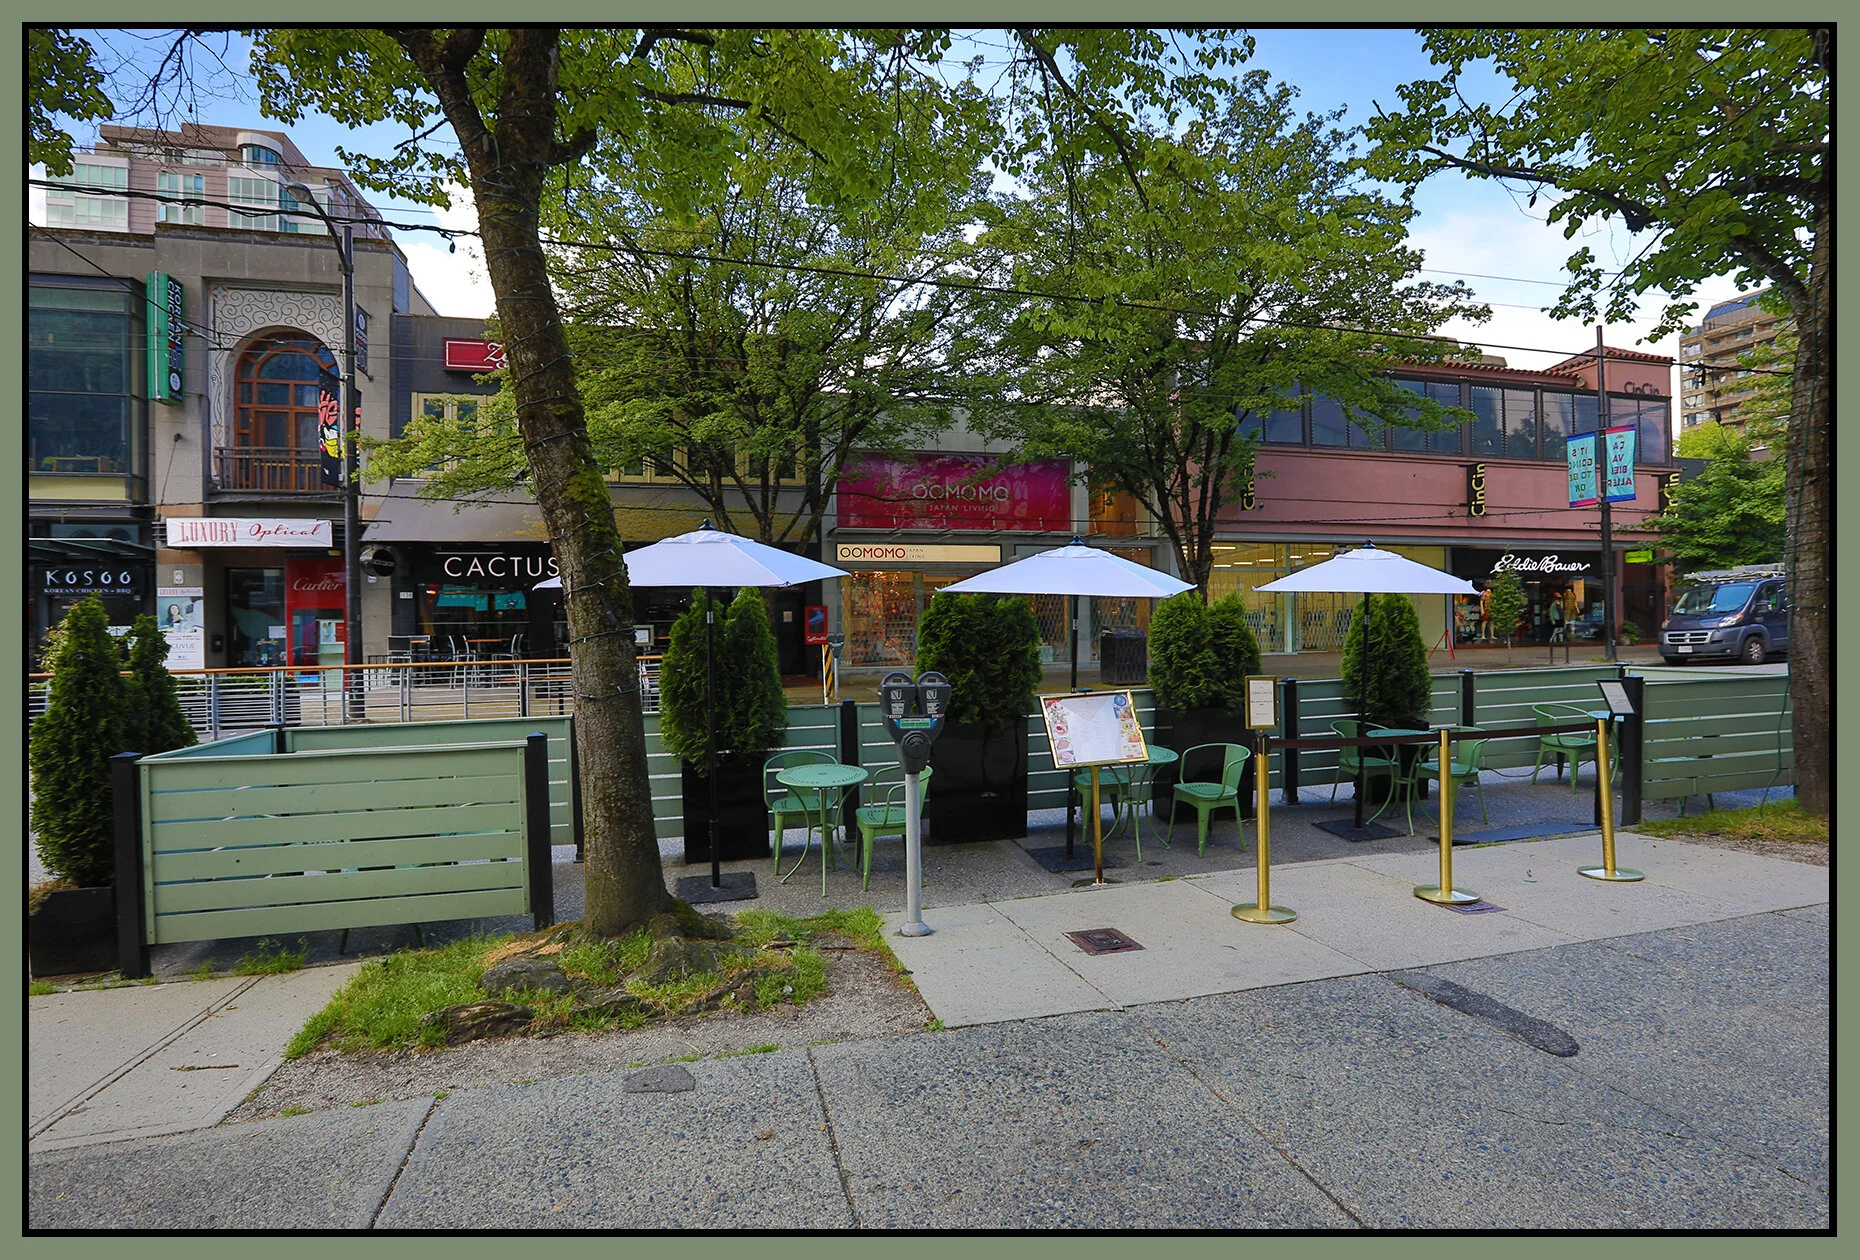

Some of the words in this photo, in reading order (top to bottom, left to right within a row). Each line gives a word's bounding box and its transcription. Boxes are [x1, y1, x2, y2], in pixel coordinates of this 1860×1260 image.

[912, 483, 1009, 501] OOMOMO
[1471, 463, 1486, 516] CinCin
[929, 504, 958, 512] JAPAN
[963, 505, 996, 513] LIVING
[180, 521, 239, 543] LUXURY
[249, 523, 321, 542] Optical
[840, 547, 906, 558] OOMOMO
[444, 556, 560, 577] CACTUS
[1490, 554, 1539, 574] Eddie
[1540, 554, 1591, 574] Bauer
[292, 577, 343, 591] Cartier
